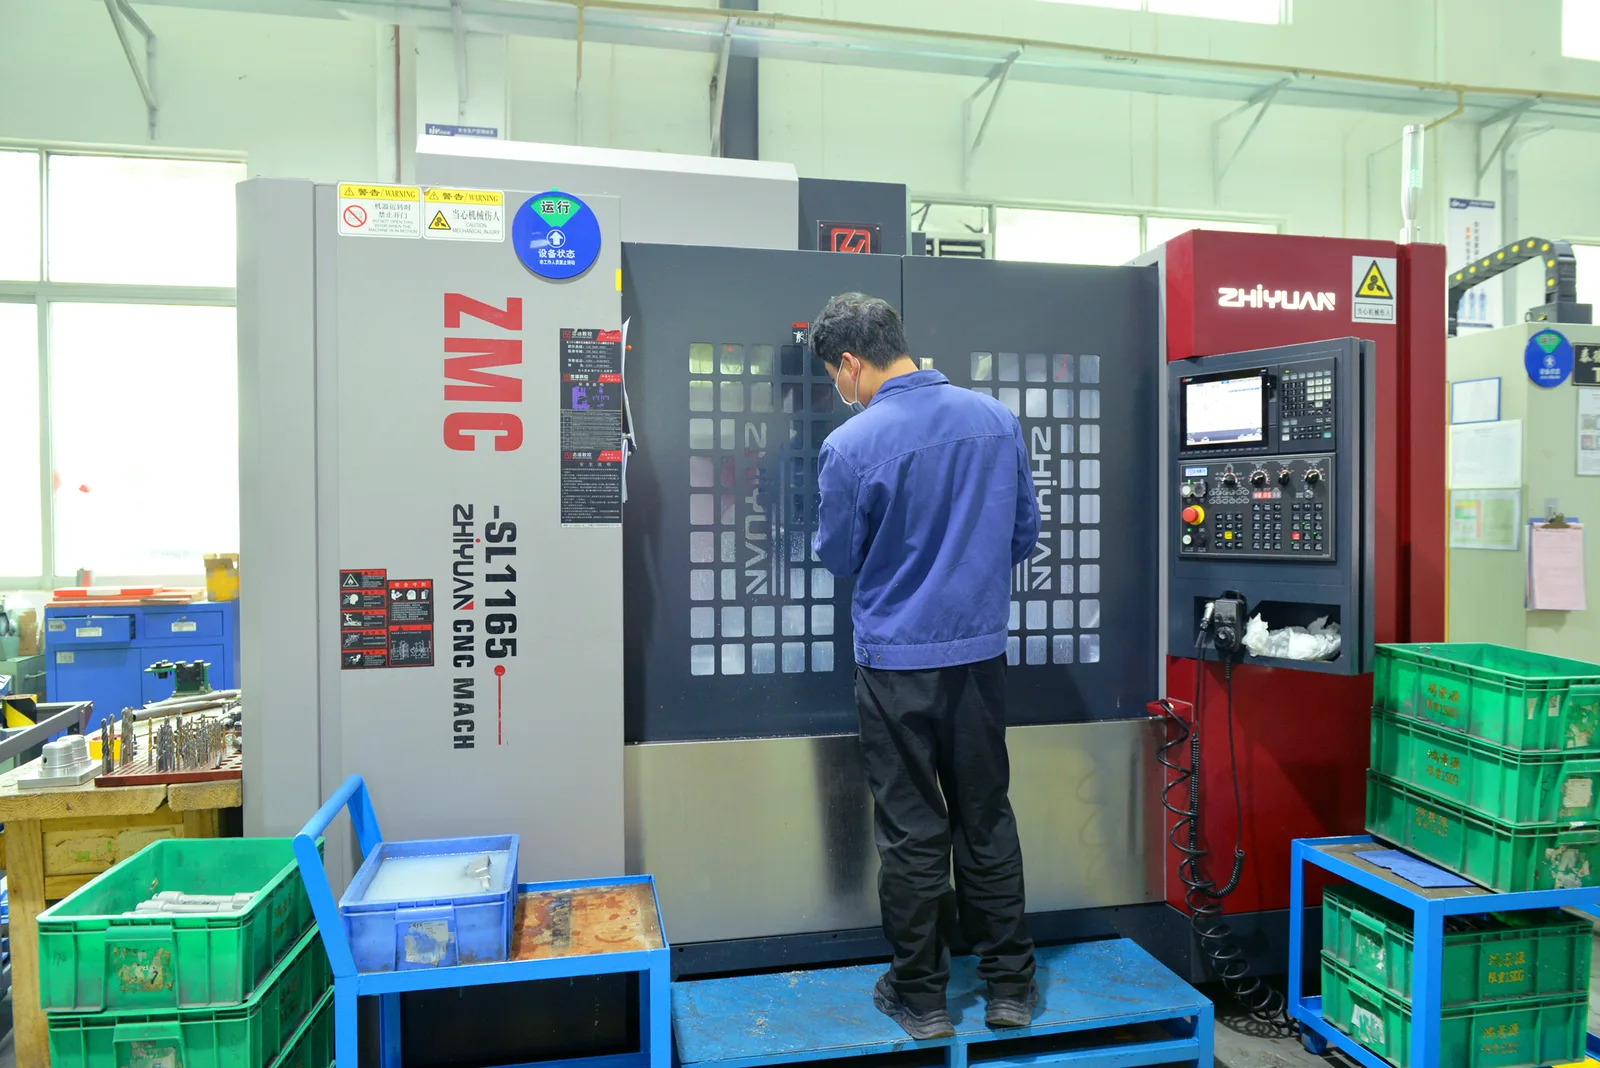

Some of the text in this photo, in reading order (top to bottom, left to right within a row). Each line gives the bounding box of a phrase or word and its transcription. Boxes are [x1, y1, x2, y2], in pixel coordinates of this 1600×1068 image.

[374, 203, 411, 211] 机器运转时
[541, 200, 571, 214] 运行
[379, 211, 408, 219] 禁止开门
[452, 208, 500, 221] 当心机械伤人
[538, 248, 576, 259] 设备状态
[443, 293, 523, 451] ZMC
[453, 619, 475, 668] CNC
[453, 678, 475, 749] MACH
